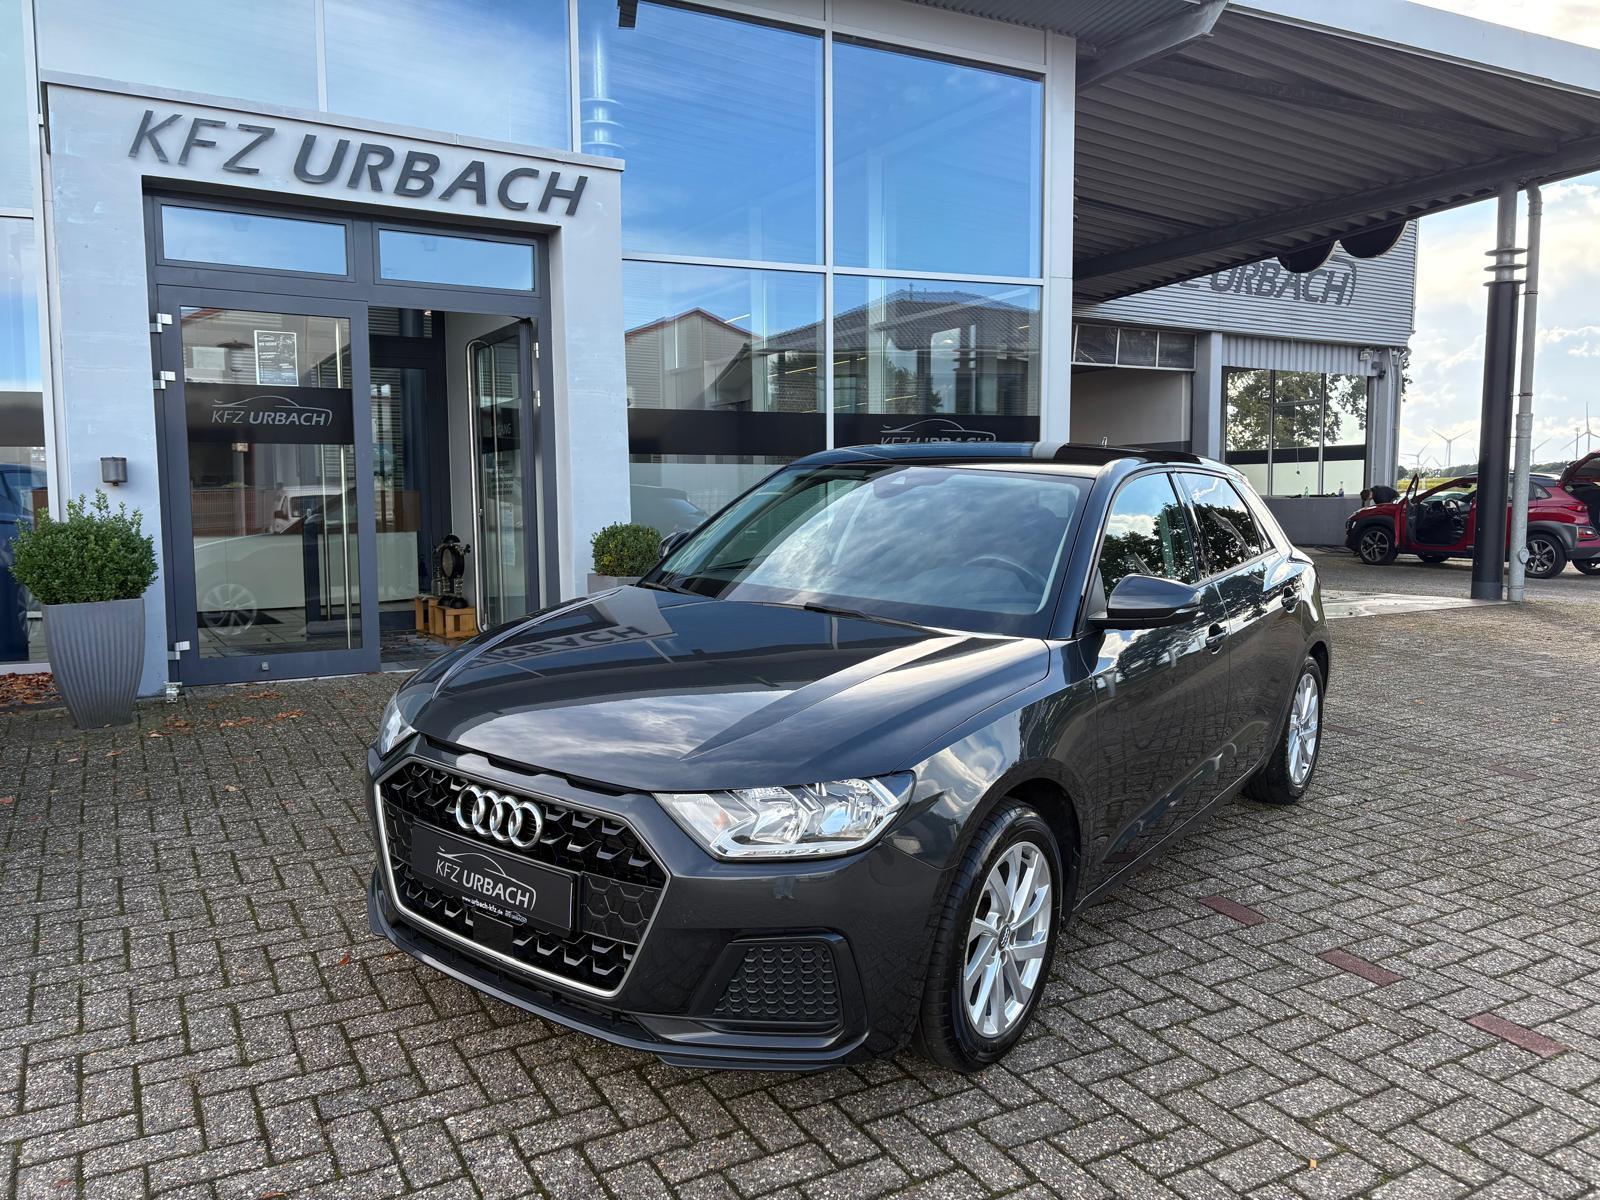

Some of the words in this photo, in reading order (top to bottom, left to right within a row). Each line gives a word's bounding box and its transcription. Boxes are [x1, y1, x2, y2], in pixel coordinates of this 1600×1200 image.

[128, 110, 276, 174] KFZ
[293, 133, 588, 216] URBACH
[1211, 262, 1350, 305] URBACH
[211, 410, 246, 424] KFZ
[249, 411, 326, 426] URBACH
[435, 859, 460, 883] KFZ
[462, 869, 530, 908] URBACH
